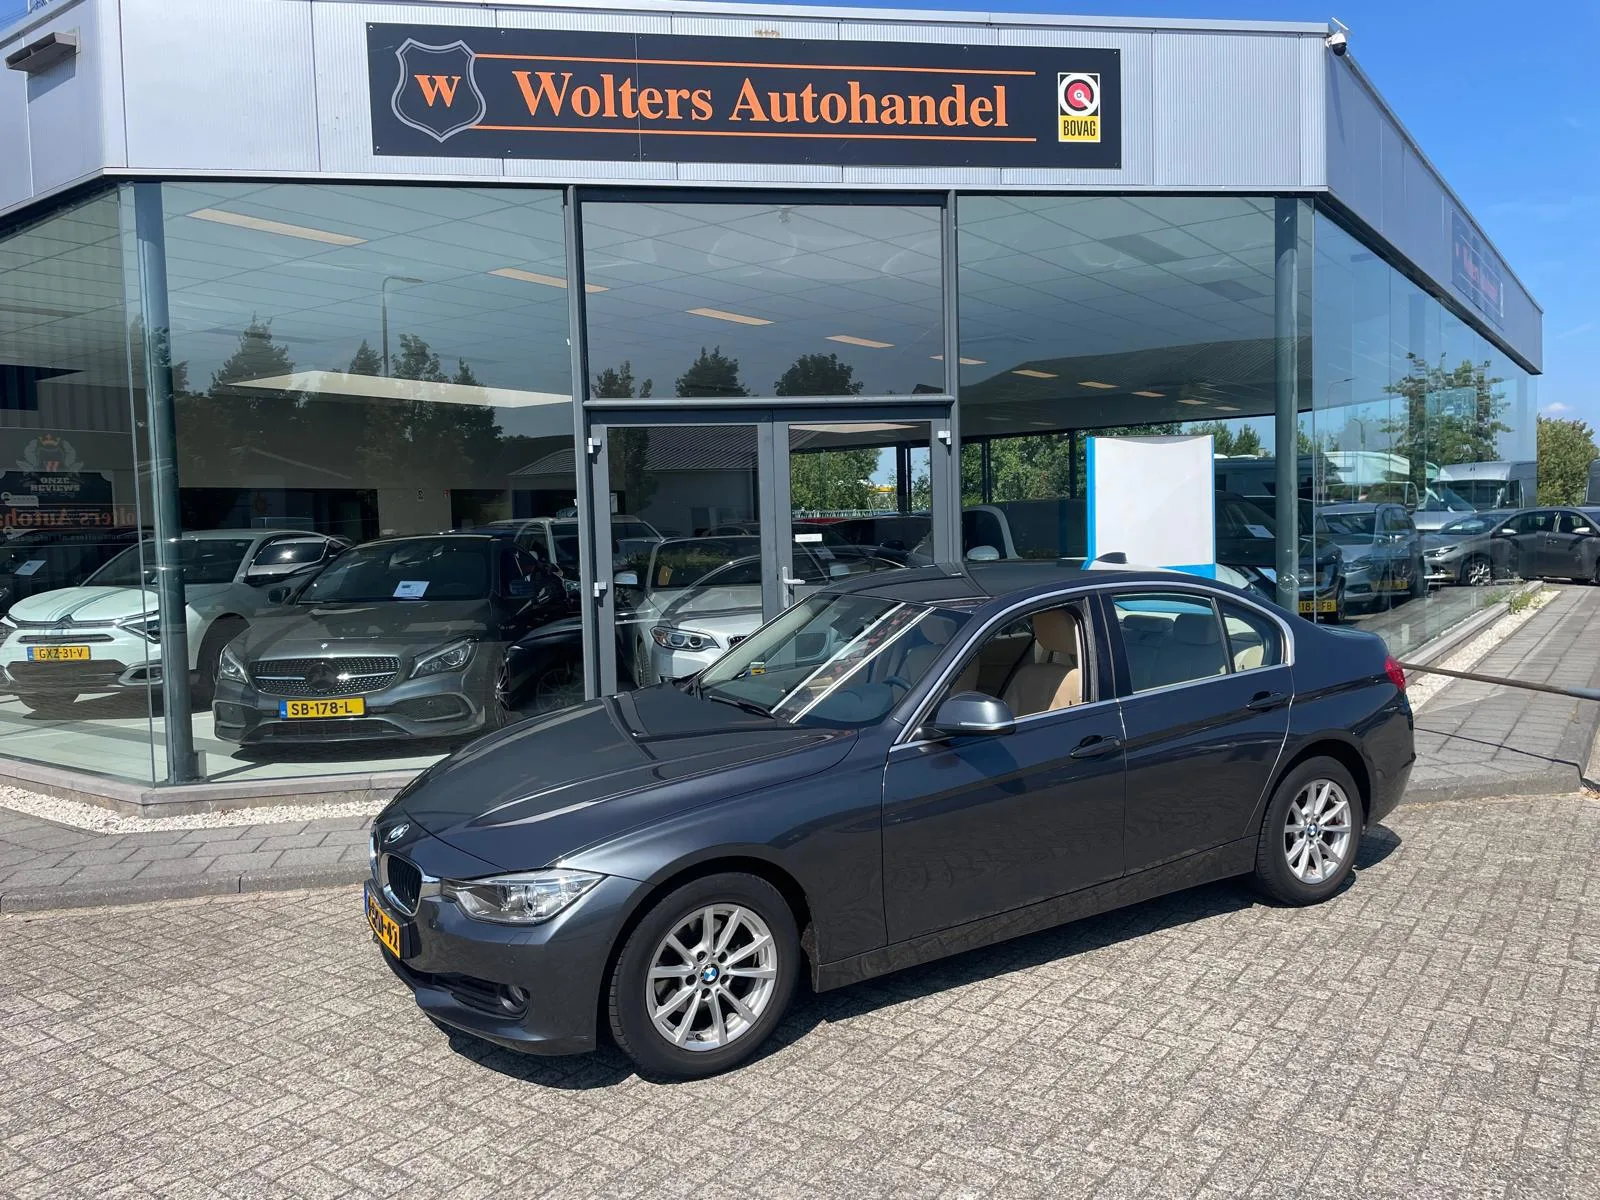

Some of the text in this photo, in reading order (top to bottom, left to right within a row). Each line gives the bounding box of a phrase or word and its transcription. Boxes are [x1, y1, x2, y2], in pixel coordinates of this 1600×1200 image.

[414, 74, 461, 108] W
[512, 71, 1009, 127] Wolters Autohandel
[1063, 119, 1097, 138] BOVAG
[39, 648, 83, 659] GXZ-31-V
[291, 701, 353, 716] SB-178-L
